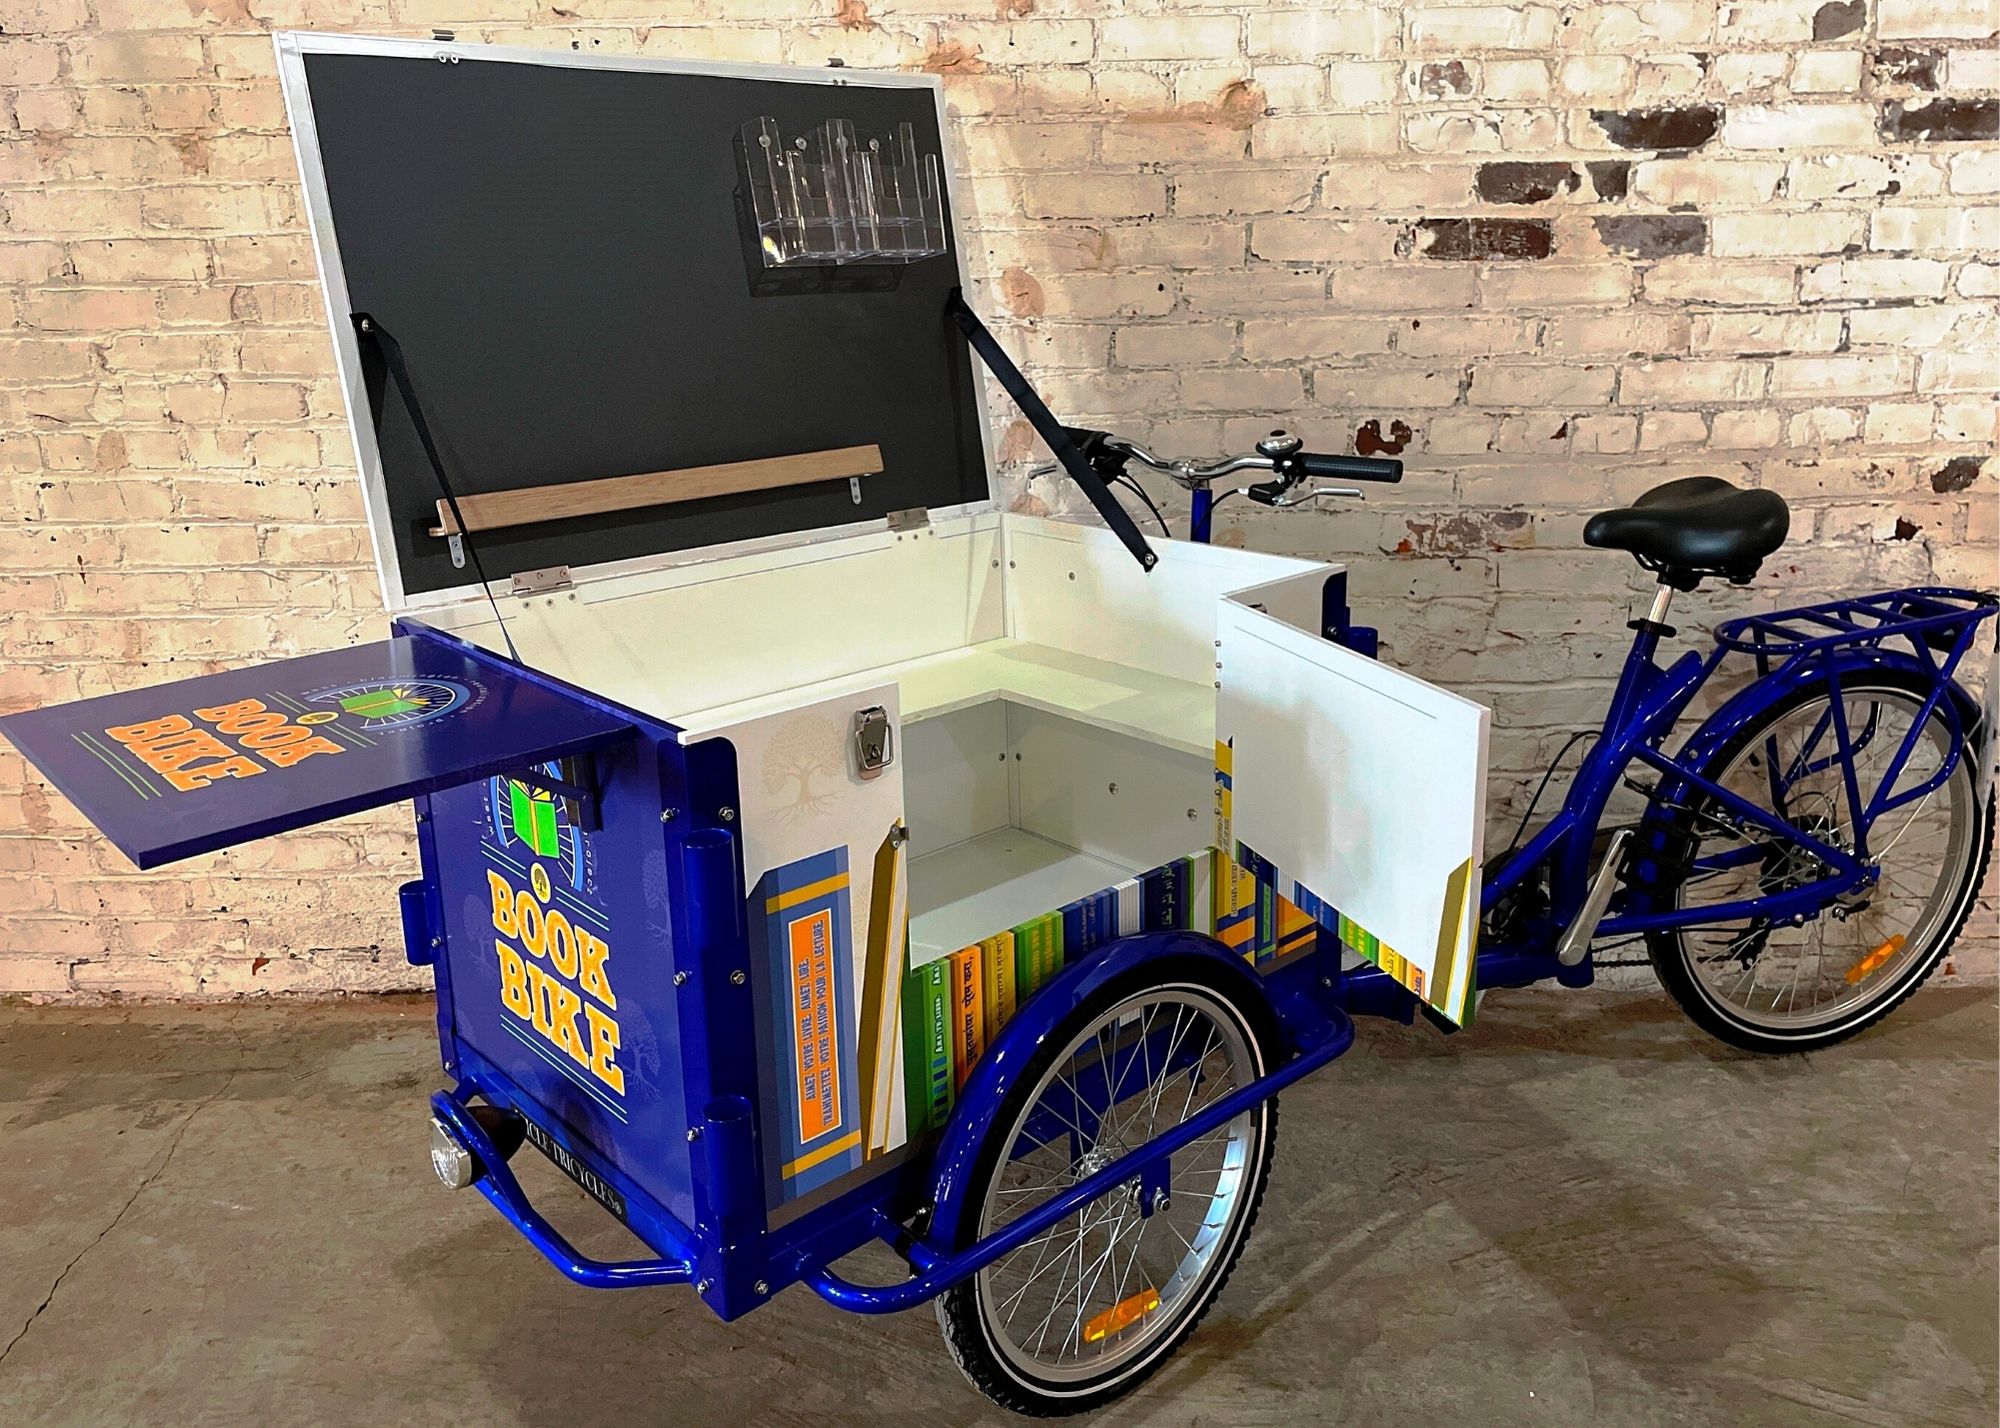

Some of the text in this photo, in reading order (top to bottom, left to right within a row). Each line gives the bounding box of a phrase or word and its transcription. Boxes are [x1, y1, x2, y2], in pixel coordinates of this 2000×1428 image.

[104, 714, 267, 793] BIKE
[193, 698, 347, 768] BOOK
[486, 868, 618, 1012] BOOK
[495, 938, 626, 1097] BIKE
[815, 975, 827, 1000] POUR
[803, 1042, 814, 1071] VOTRE
[819, 1036, 830, 1065] VOTRE
